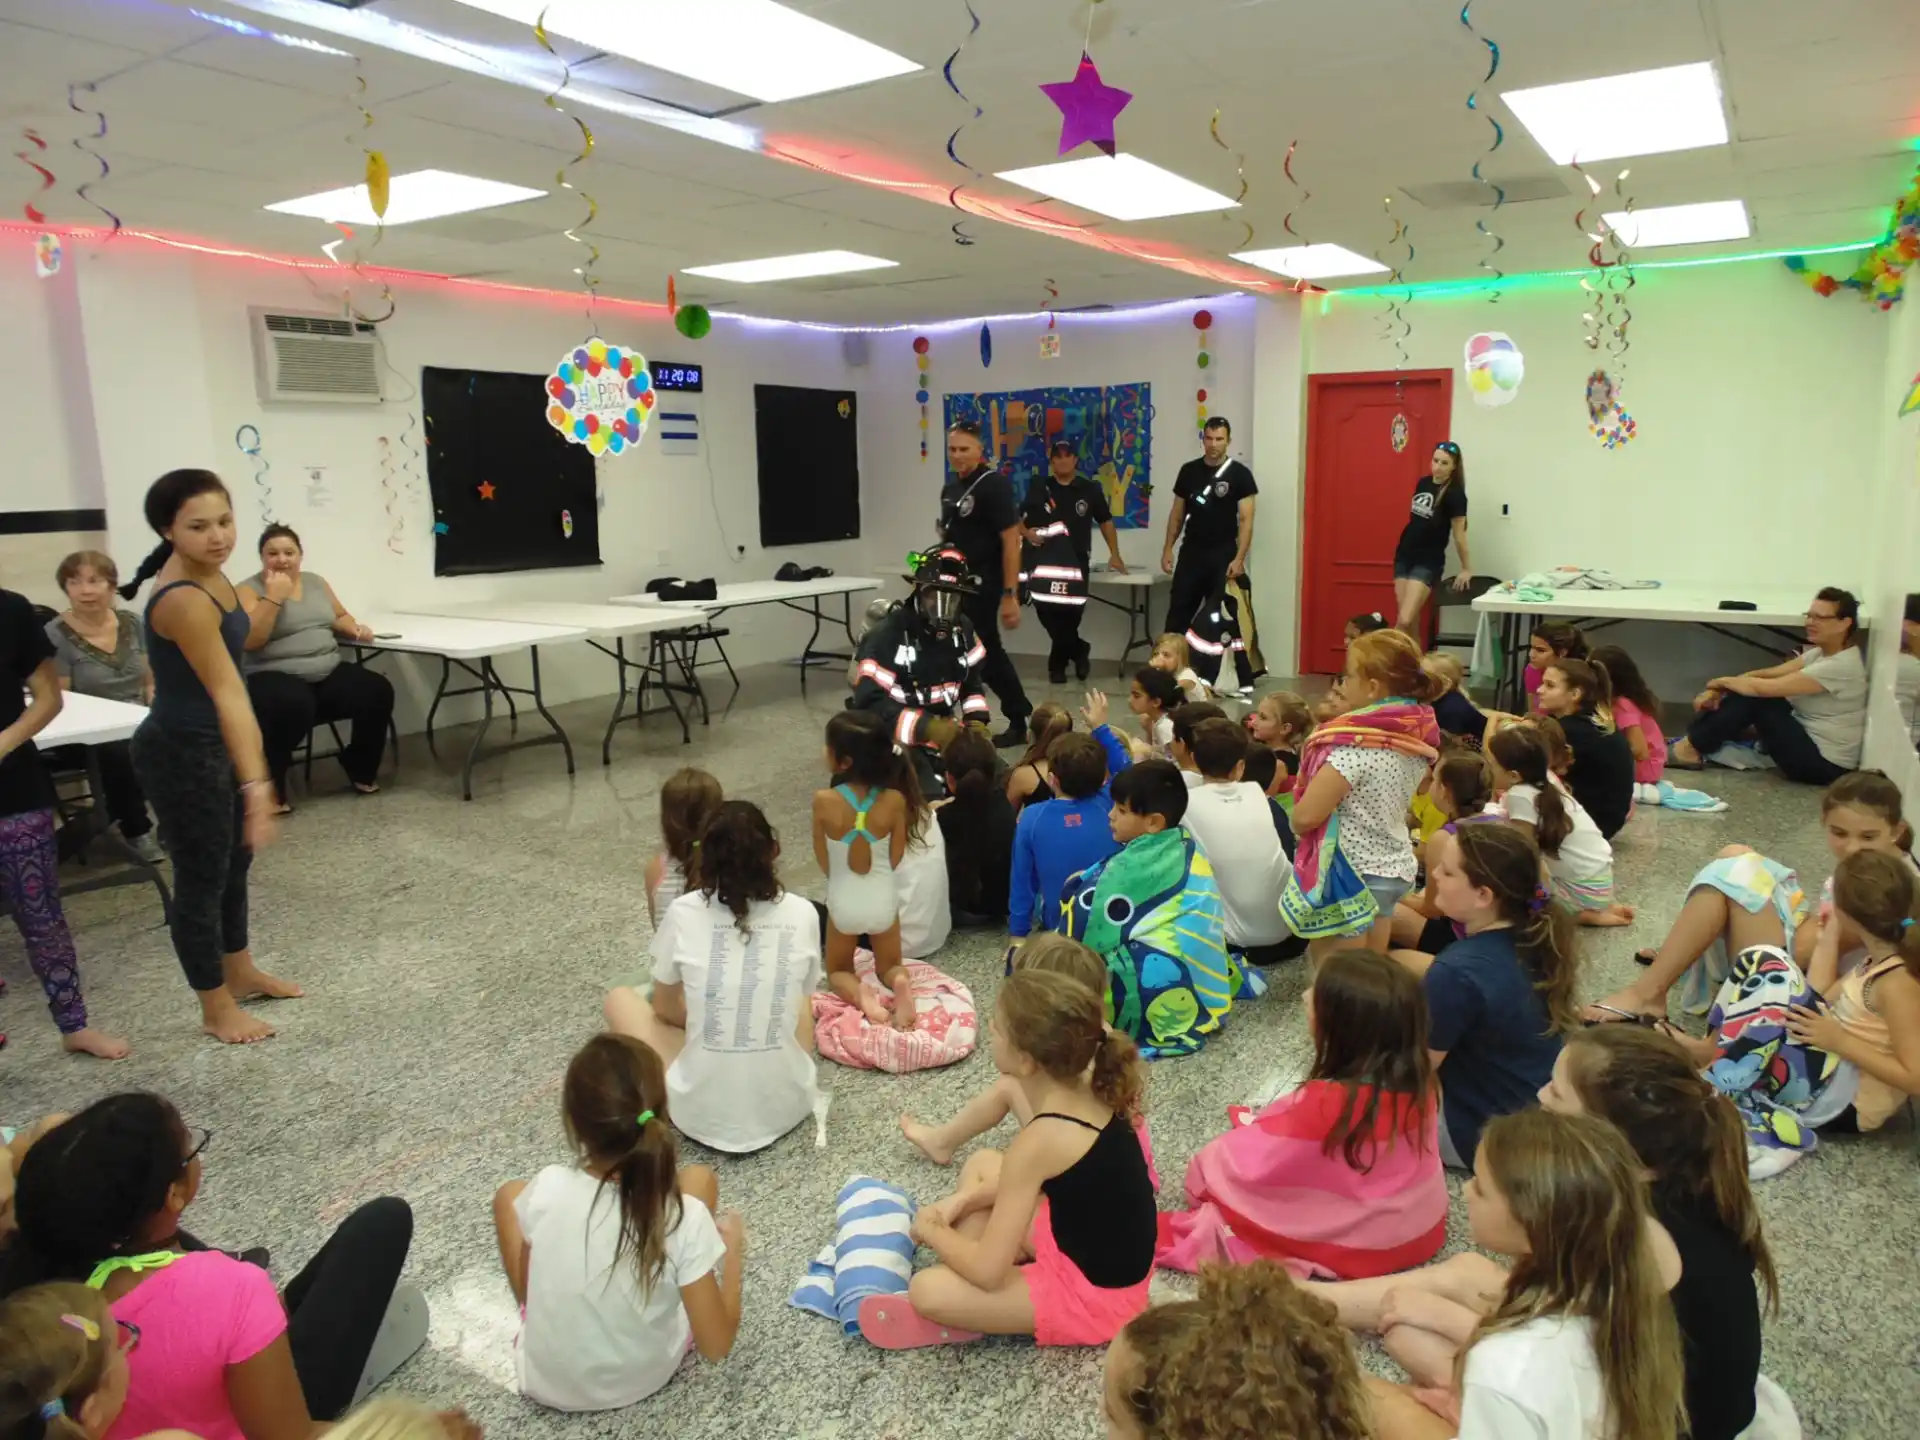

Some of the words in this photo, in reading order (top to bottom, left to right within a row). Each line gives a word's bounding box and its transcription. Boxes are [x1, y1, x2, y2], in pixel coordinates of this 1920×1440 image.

[671, 369, 684, 382] 20
[686, 370, 699, 383] 08
[1050, 581, 1069, 594] BEE
